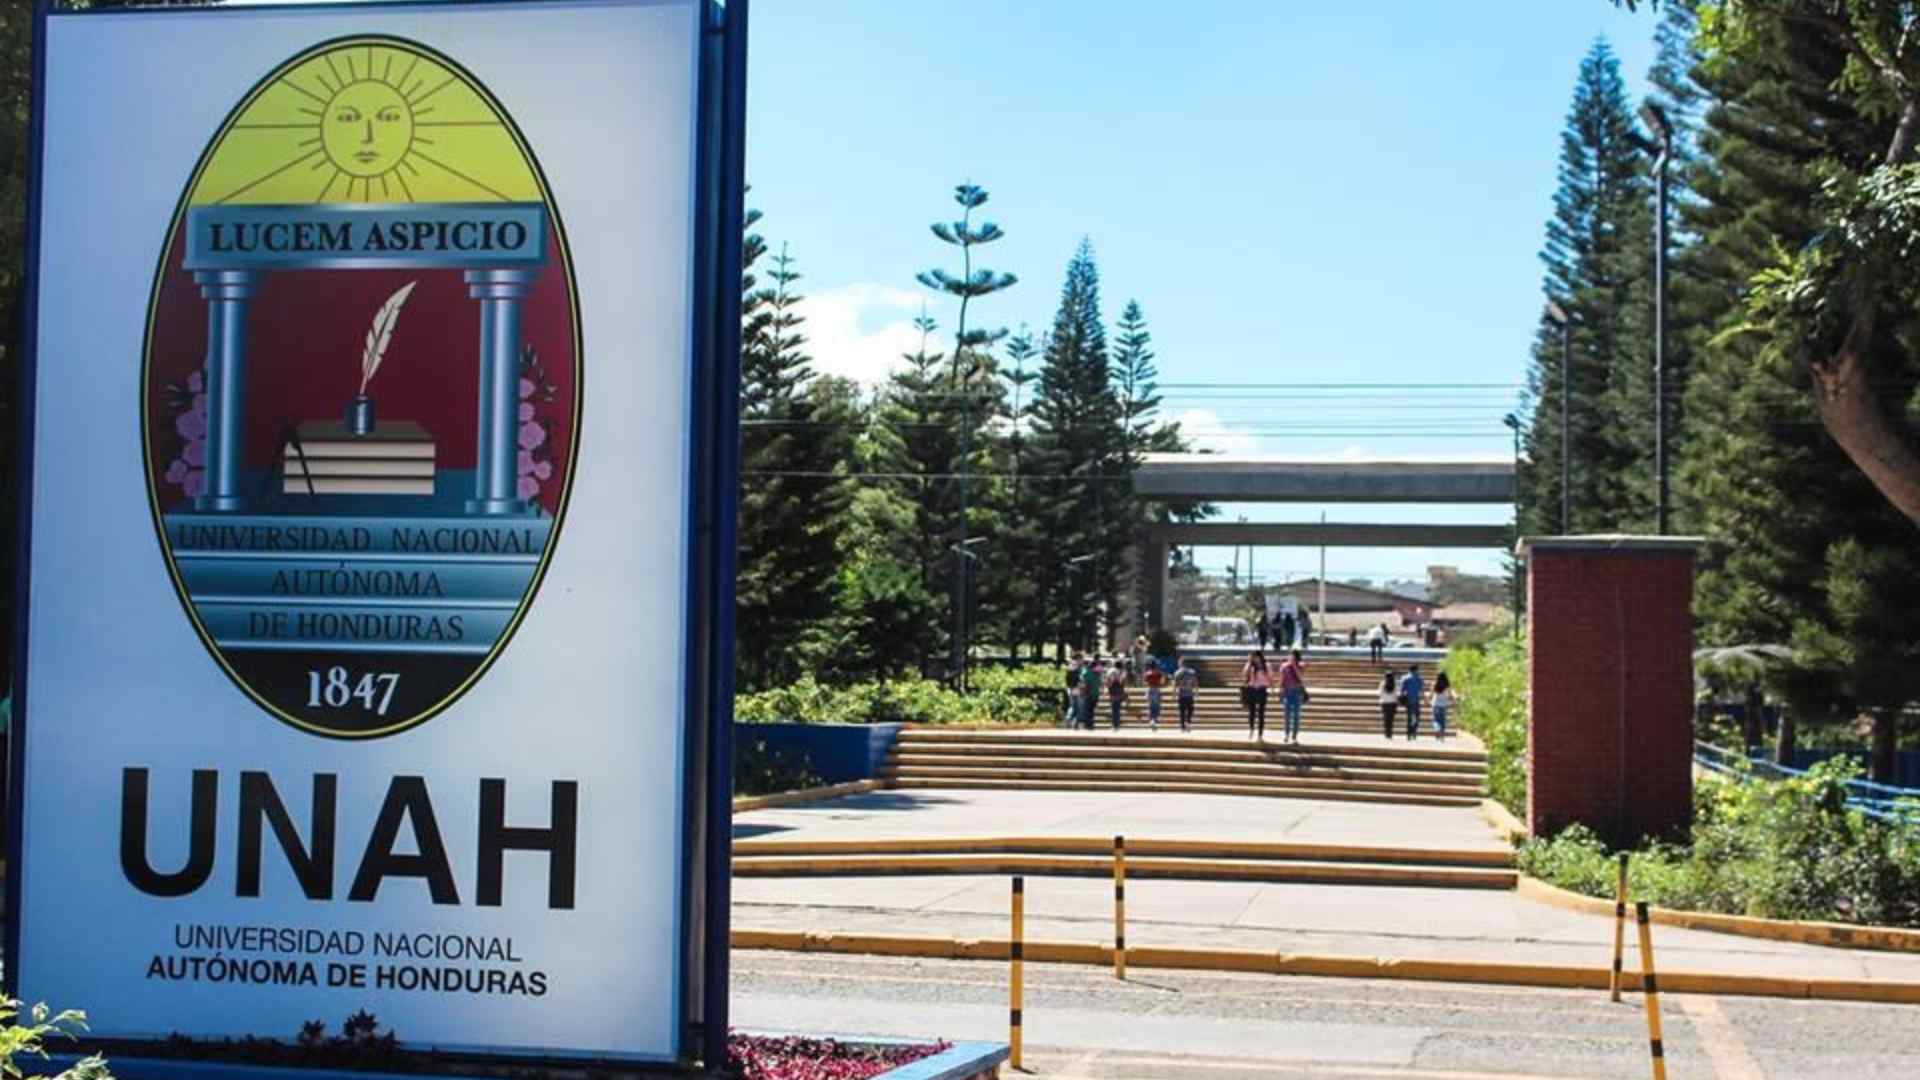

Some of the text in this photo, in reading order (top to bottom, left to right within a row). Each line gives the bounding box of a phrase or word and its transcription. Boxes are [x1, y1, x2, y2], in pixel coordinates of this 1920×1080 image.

[209, 220, 527, 252] LUCEM ASPICIO
[179, 524, 540, 554] UNIVERSIDAD NACIONAL
[271, 561, 446, 598] AUTÓNOMA
[249, 612, 464, 641] DE HONDURAS
[307, 666, 400, 715] 1847
[120, 767, 578, 910] UNAH
[174, 924, 523, 963] UNIVERSIDAD NACIONAL
[146, 952, 548, 997] AUTÓNOMA DE HONDURAS
